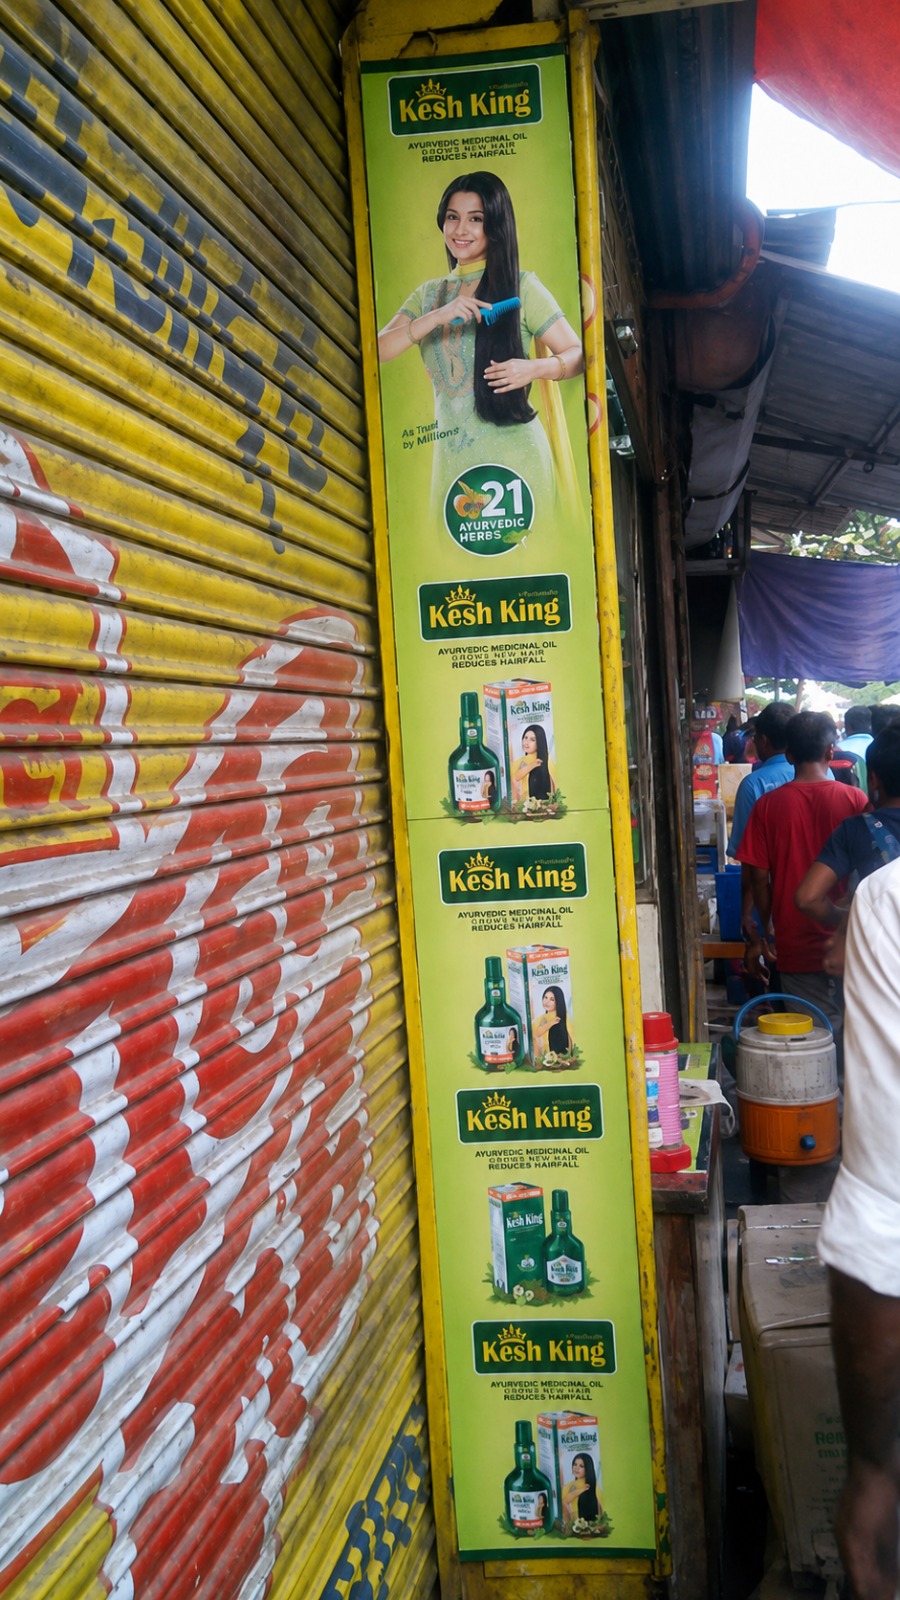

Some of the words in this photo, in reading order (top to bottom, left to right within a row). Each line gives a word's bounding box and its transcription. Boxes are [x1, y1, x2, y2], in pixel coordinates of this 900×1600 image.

[400, 95, 462, 122] Kesh
[470, 89, 531, 118] King
[408, 139, 459, 150] AYURVEDIC
[462, 135, 510, 145] MEDICINAL
[423, 153, 467, 162] REDUCES
[470, 149, 516, 158] HAIRFALL
[402, 429, 414, 438] As
[403, 441, 414, 449] by
[417, 427, 459, 445] Millions
[481, 479, 523, 517] 21
[460, 518, 524, 531] AYURVEDIC
[460, 531, 501, 542] HERBS
[429, 602, 492, 628] Kesh
[500, 598, 561, 626] King
[438, 646, 488, 655] AYURVEDIC
[491, 643, 540, 652] MEDICINAL
[452, 659, 496, 668] REDUCES
[500, 657, 545, 665] HAIRFALL
[449, 868, 510, 892] Kesh
[518, 864, 577, 892] King
[458, 910, 506, 919] AYURVEDIC
[509, 908, 556, 916] MEDICINAL
[472, 923, 515, 932] REDUCES
[518, 921, 563, 929] HAIRFALL
[467, 1107, 527, 1131] Kesh
[534, 1106, 592, 1132] King
[475, 1148, 523, 1157] AYURVEDIC
[489, 1162, 531, 1170] REDUCES
[482, 1340, 542, 1362] Kesh
[549, 1340, 606, 1368] King
